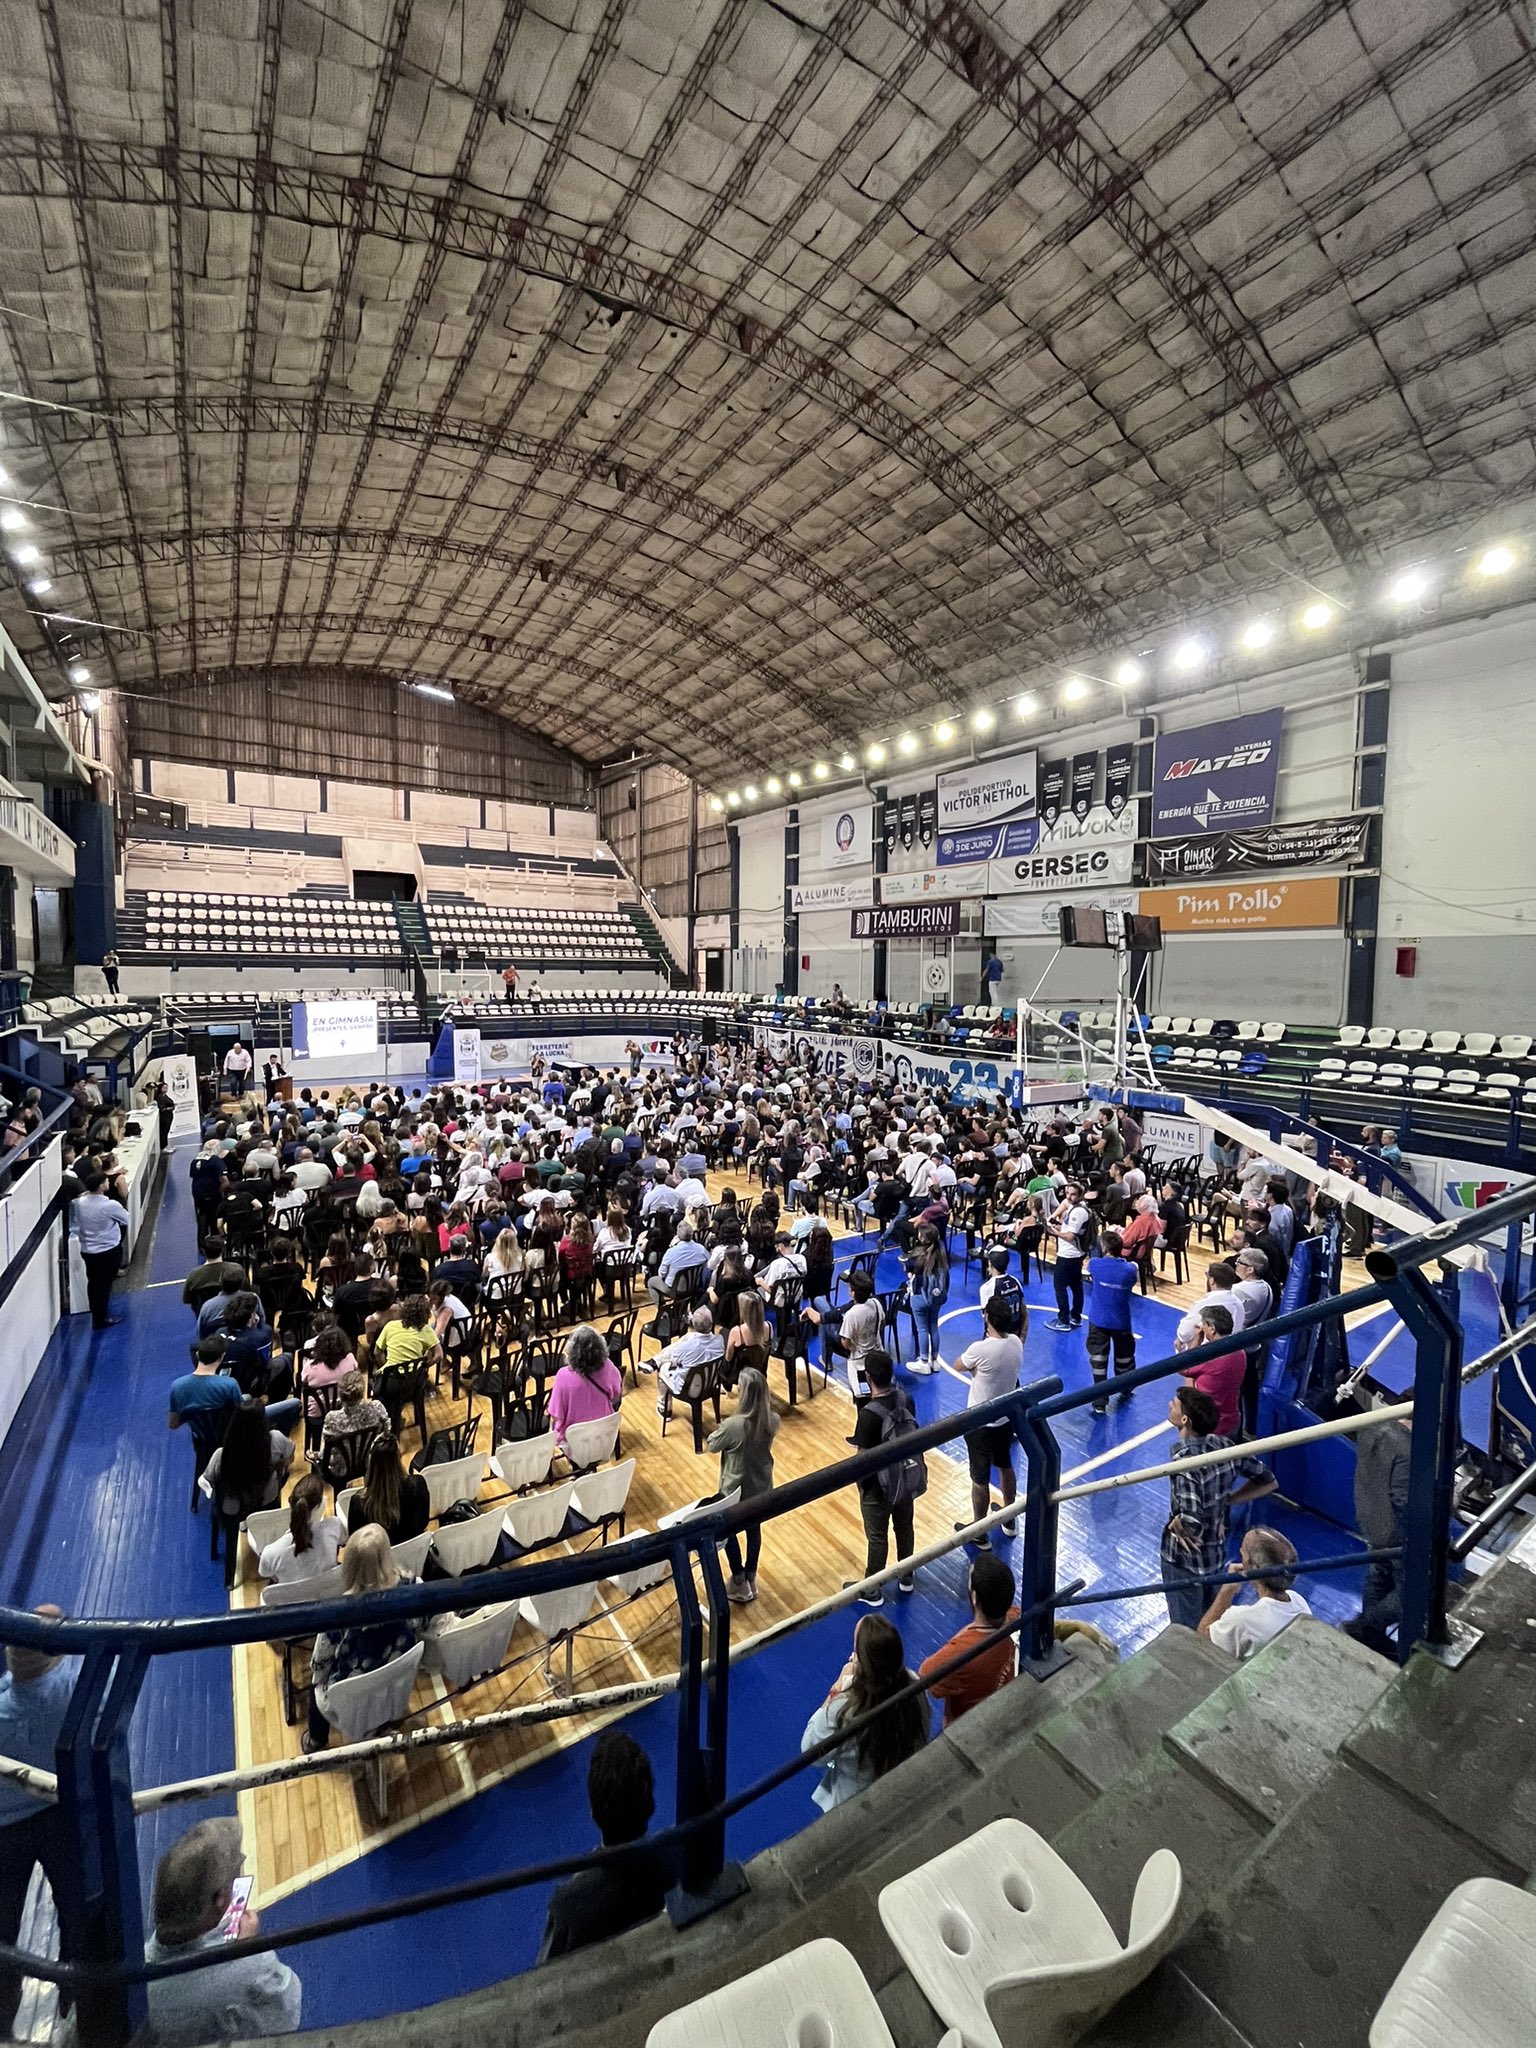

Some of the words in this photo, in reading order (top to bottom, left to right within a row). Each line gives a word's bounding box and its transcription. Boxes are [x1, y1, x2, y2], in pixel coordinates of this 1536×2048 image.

[1234, 739, 1272, 753] BATERIAS
[1163, 747, 1272, 781] MATEO
[958, 779, 1012, 798] POLIDEPORTIVO
[943, 794, 980, 813] VICTOR
[983, 783, 1030, 805] NETHOL
[1158, 805, 1191, 820] ENERGÍA
[1193, 802, 1209, 815] QUE
[1211, 802, 1221, 812] TE
[1222, 795, 1266, 810] POTENCIA
[954, 844, 960, 852] 3
[960, 842, 970, 851] DE
[970, 839, 993, 850] JUNIO
[1014, 850, 1109, 880] GERSEG
[804, 886, 846, 900] ALUMINE
[1177, 895, 1220, 914] Pim
[871, 906, 953, 929] TAMBURINI
[1191, 917, 1214, 926] Mucho
[1216, 916, 1230, 925] más
[1232, 916, 1246, 925] que
[1247, 915, 1267, 924] pollo
[873, 925, 952, 935] AMOBLAMIENTOS
[312, 1017, 326, 1026] EN
[328, 1015, 374, 1025] GIMNASIA
[531, 1042, 569, 1051] FERRETERÍA
[1141, 1125, 1195, 1143] LUMINE
